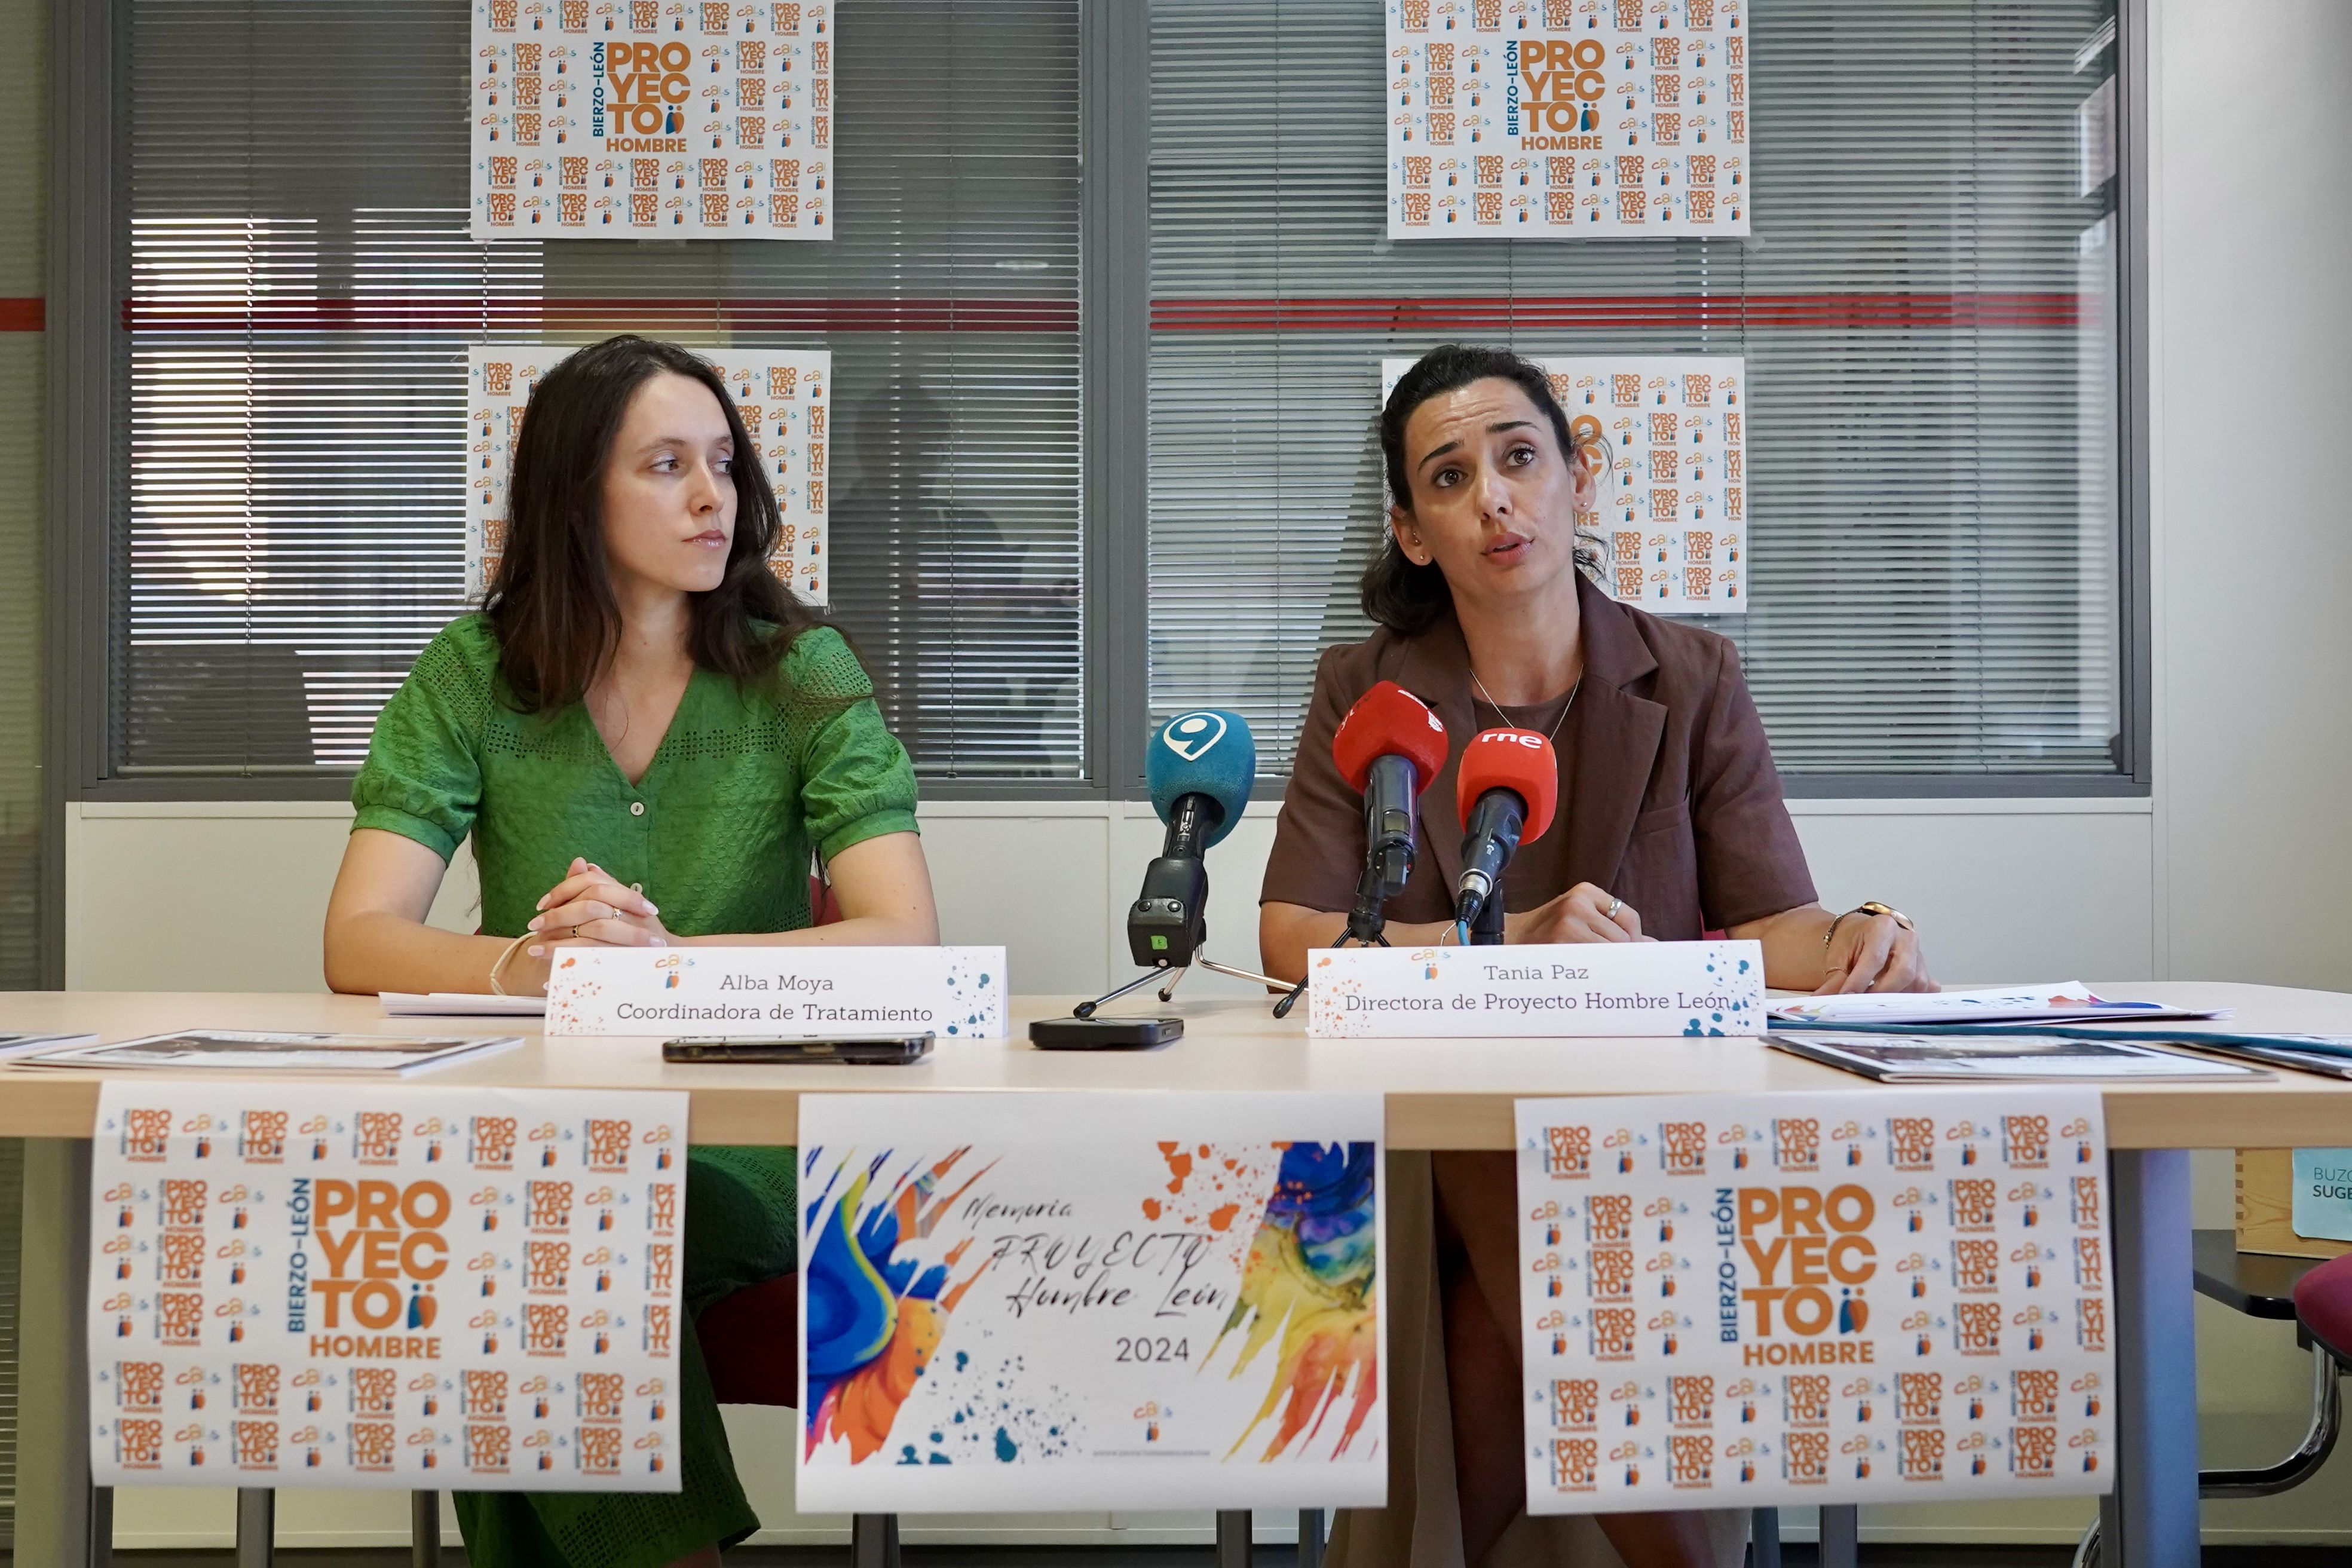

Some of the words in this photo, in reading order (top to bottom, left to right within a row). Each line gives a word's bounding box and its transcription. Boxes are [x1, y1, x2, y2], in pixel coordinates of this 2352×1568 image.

[705, 2, 728, 12] PRO
[705, 12, 729, 20] YEC
[705, 21, 721, 30] TO
[517, 44, 541, 53] PRO
[1429, 43, 1453, 53] PRO
[517, 53, 541, 62] YEC
[607, 42, 691, 72] PRO
[1429, 53, 1454, 61] YEC
[1520, 39, 1605, 70] PRO
[517, 62, 533, 71] TO
[1430, 62, 1445, 71] TO
[741, 78, 765, 87] PRO
[1656, 75, 1680, 84] PRO
[590, 42, 604, 137] BIERZO-LEÓN
[607, 73, 690, 103] YEC
[1503, 41, 1517, 135] BIERZO-LEÓN
[1521, 71, 1605, 101] YEC
[1656, 84, 1680, 93] YEC
[741, 88, 765, 96] YEC
[742, 97, 757, 106] TO
[1656, 93, 1672, 102] TO
[607, 104, 663, 134] TO
[1521, 102, 1578, 133] TO
[607, 139, 686, 152] HOMBRE
[1521, 136, 1602, 151] HOMBRE
[564, 157, 587, 166] PRO
[775, 160, 799, 169] PRO
[1478, 156, 1502, 165] PRO
[1619, 156, 1643, 165] PRO
[564, 166, 588, 174] YEC
[775, 169, 800, 177] YEC
[1478, 166, 1503, 174] YEC
[1619, 166, 1644, 174] YEC
[564, 175, 580, 184] TO
[776, 178, 791, 187] TO
[1479, 174, 1494, 183] TO
[1620, 174, 1635, 183] TO
[633, 194, 657, 203] PRO
[1549, 191, 1573, 201] PRO
[1690, 191, 1714, 200] PRO
[633, 204, 658, 212] YEC
[1549, 201, 1574, 209] YEC
[1690, 200, 1714, 209] YEC
[634, 213, 649, 222] TO
[1550, 210, 1566, 219] TO
[1690, 209, 1705, 218] TO
[488, 363, 512, 372] PRO
[488, 372, 512, 381] YEC
[1686, 375, 1710, 384] PRO
[488, 381, 503, 390] TO
[1686, 384, 1711, 393] YEC
[1687, 393, 1702, 402] TO
[1653, 414, 1677, 423] PRO
[1653, 423, 1677, 431] YEC
[1653, 432, 1668, 441] TO
[1653, 489, 1677, 498] PRO
[1653, 498, 1678, 507] YEC
[1654, 507, 1670, 516] TO
[1688, 532, 1711, 541] PRO
[1688, 541, 1712, 550] YEC
[1688, 550, 1703, 559] TO
[1687, 568, 1711, 577] PRO
[1687, 577, 1711, 586] YEC
[1688, 586, 1703, 595] TO
[1482, 732, 1543, 749] rne
[1484, 965, 1543, 981] Tania
[1551, 965, 1589, 981] Paz
[719, 975, 769, 991] Alba
[777, 975, 834, 994] Moya
[1346, 994, 1443, 1012] Directora
[1452, 994, 1476, 1010] de
[1485, 994, 1577, 1015] Proyecto
[1585, 993, 1670, 1010] Hombre
[1677, 992, 1729, 1010] León
[617, 1003, 761, 1021] Coordinadora
[770, 1003, 794, 1020] de
[803, 1004, 933, 1021] Tratamiento
[314, 1180, 451, 1229] PRO
[962, 1193, 1073, 1230] Memoria
[1738, 1185, 1875, 1235] PRO
[286, 1178, 310, 1333] BIERZO-LEÓN
[314, 1231, 449, 1281] YEC
[993, 1230, 1211, 1279] PROYECTO
[1740, 1235, 1876, 1286] YEC
[1715, 1188, 1738, 1343] BIERZO-LEÓN
[1006, 1270, 1132, 1318] Hombre
[311, 1279, 402, 1330] TO
[1742, 1287, 1833, 1337] TO
[310, 1336, 441, 1359] HOMBRE
[1116, 1337, 1189, 1362] 2024
[1744, 1343, 1874, 1365] HOMBRE
